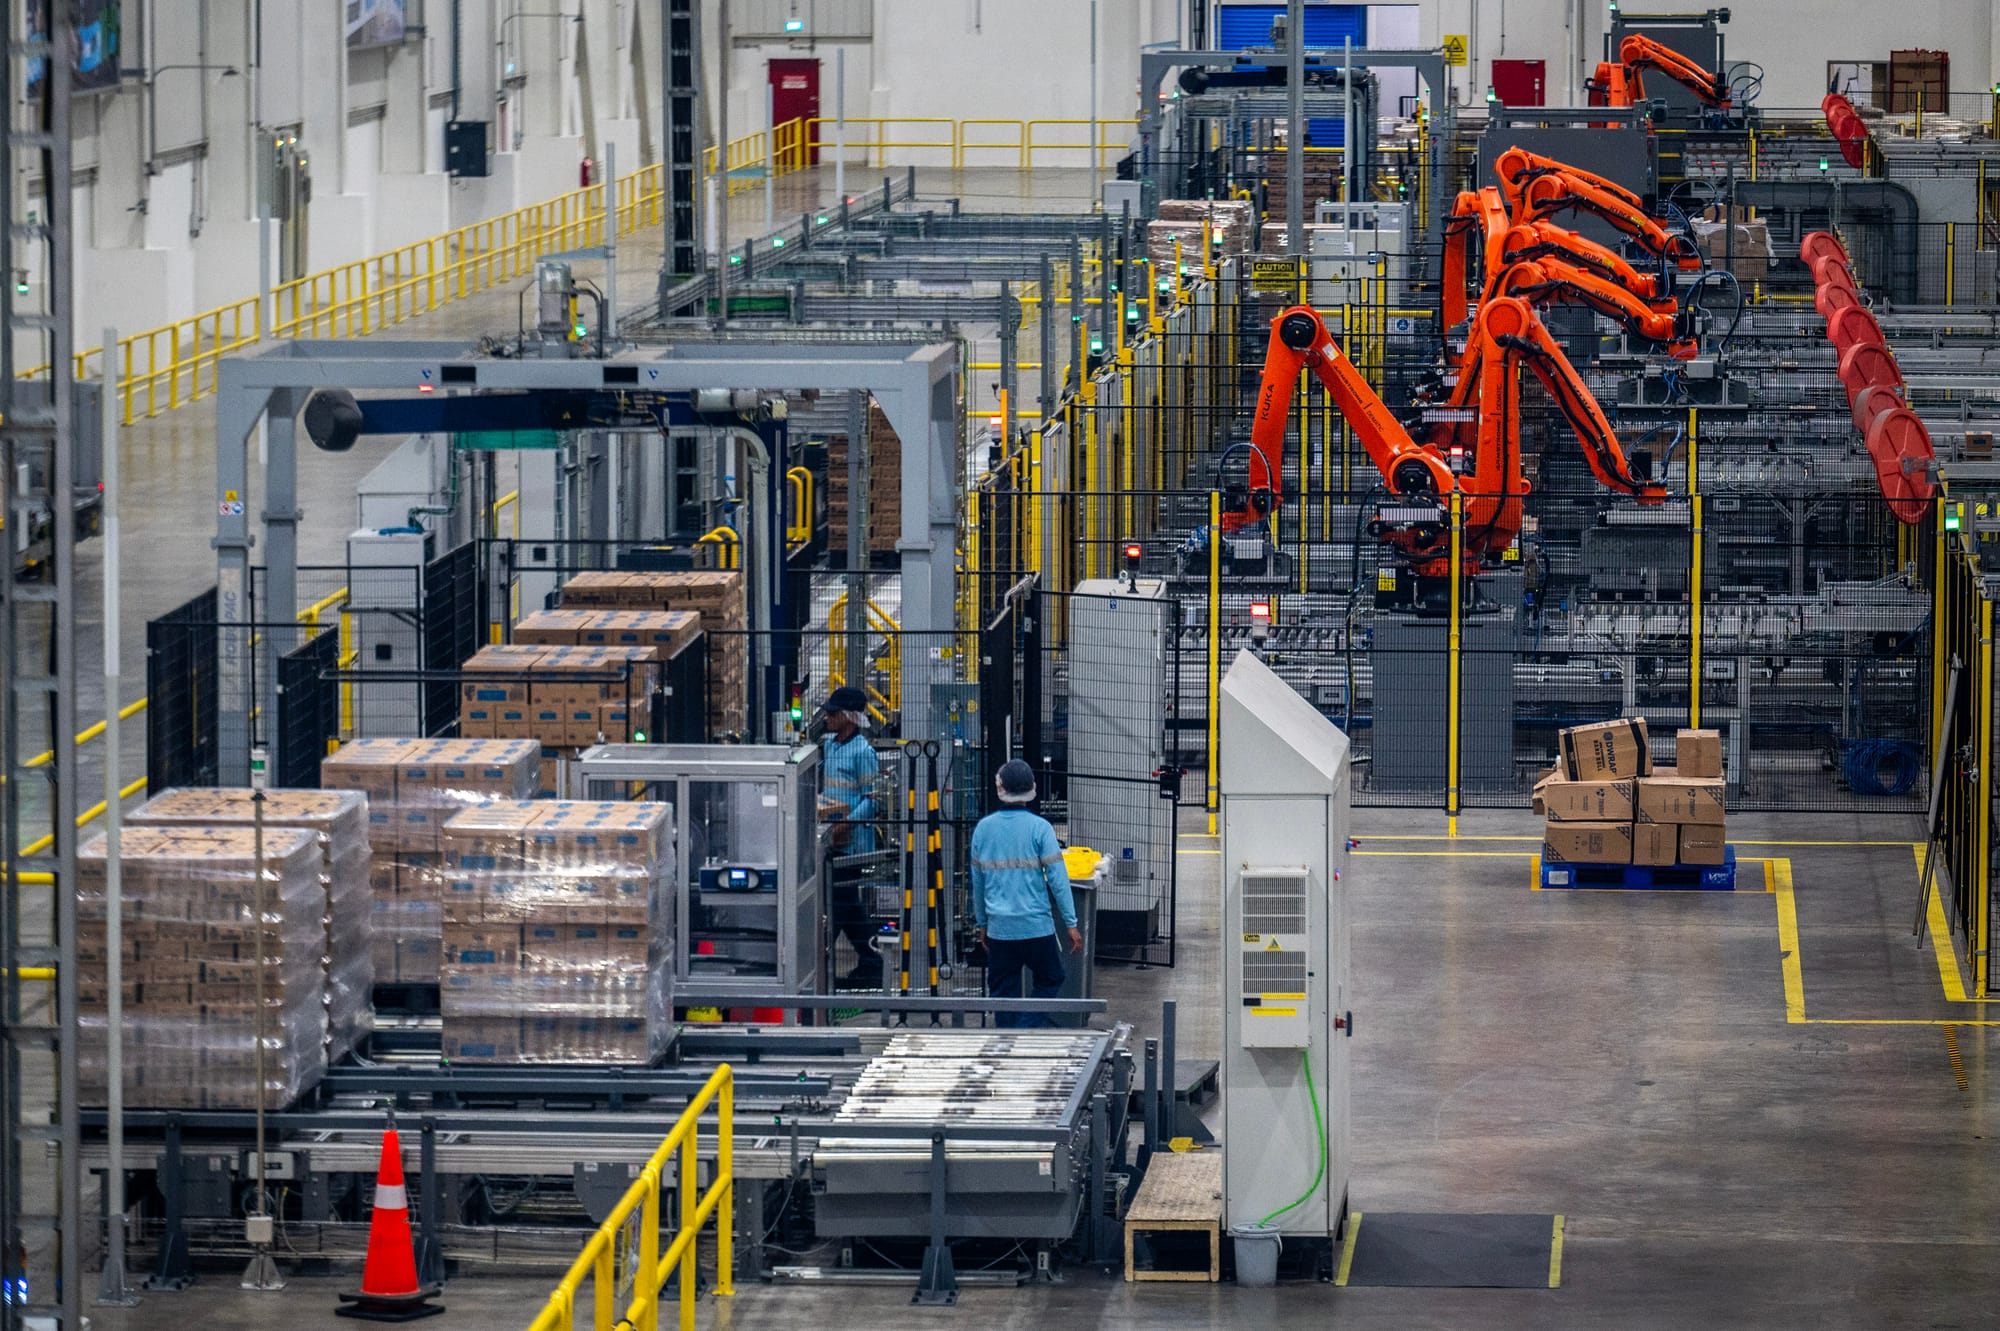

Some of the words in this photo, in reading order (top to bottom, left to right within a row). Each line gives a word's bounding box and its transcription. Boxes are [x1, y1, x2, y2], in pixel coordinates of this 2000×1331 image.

[1610, 206, 1632, 220] KUKA
[1583, 251, 1603, 264] KUKA
[1255, 262, 1293, 271] CAUTION
[1594, 289, 1616, 303] KUKA
[1261, 383, 1275, 421] KUKA
[1366, 410, 1385, 432] DEMATIC
[1605, 742, 1618, 774] DWRAP
